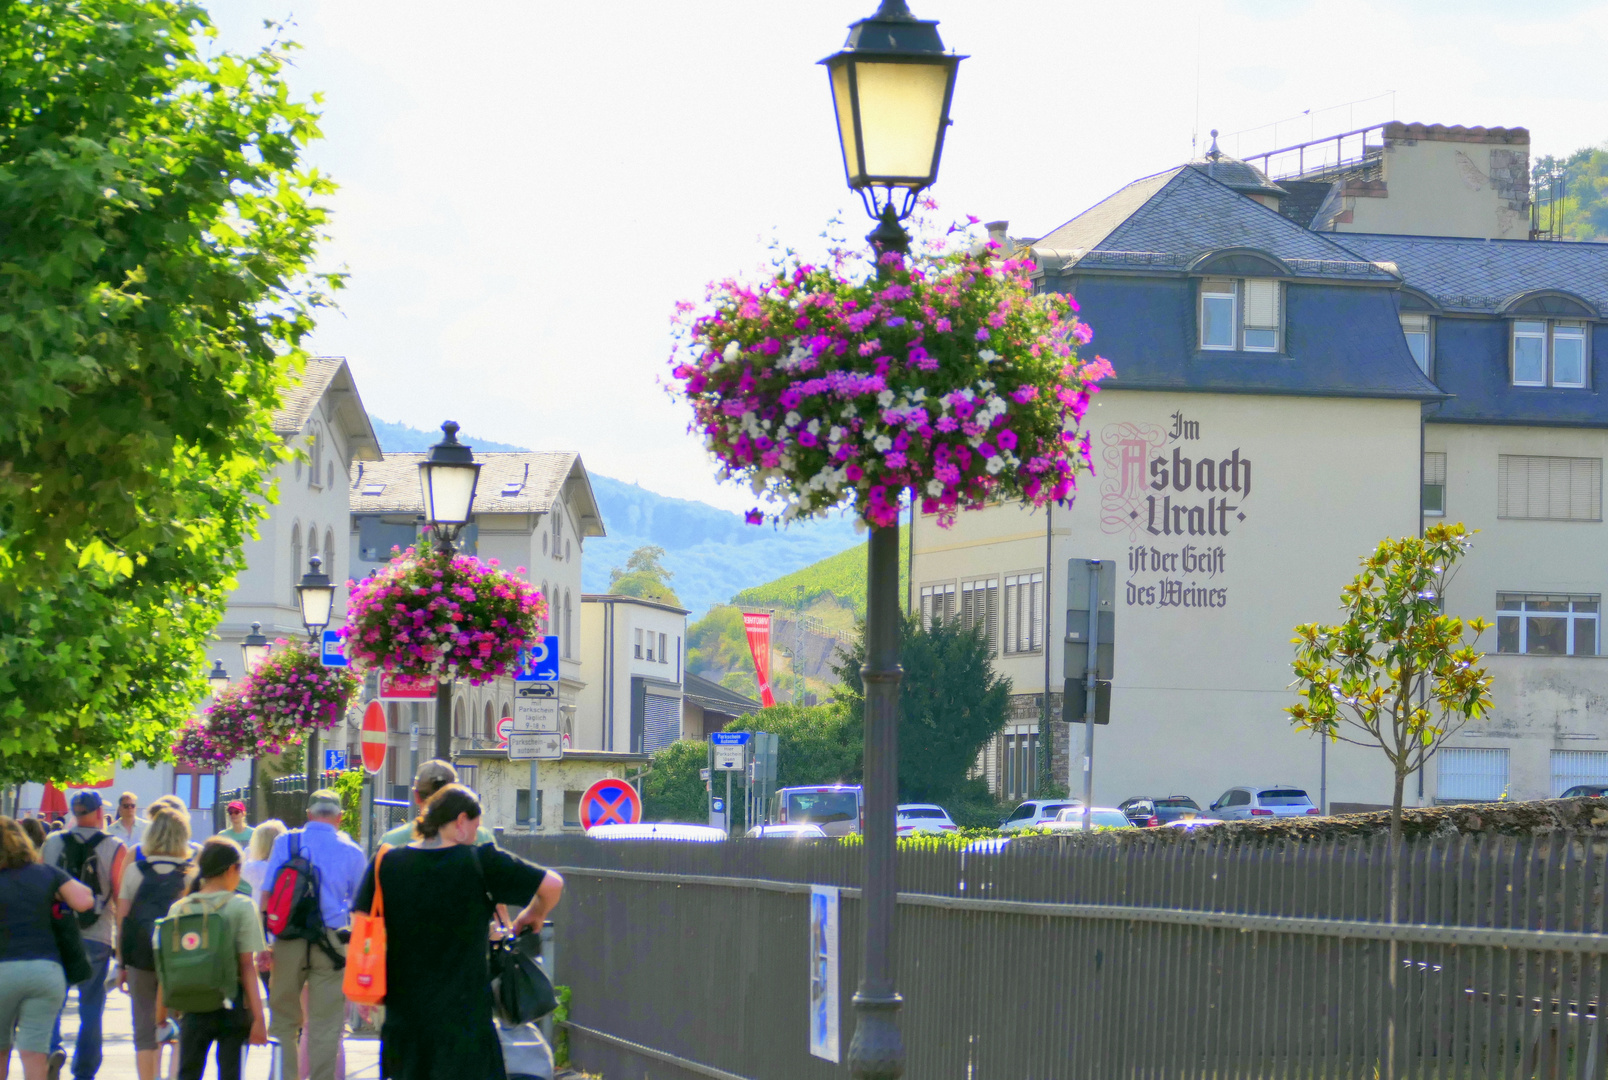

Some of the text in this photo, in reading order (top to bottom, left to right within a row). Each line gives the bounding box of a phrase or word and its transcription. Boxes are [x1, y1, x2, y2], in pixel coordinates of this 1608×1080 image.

[1168, 409, 1201, 443] Im
[1117, 439, 1252, 502] Asbach
[1150, 546, 1178, 573] der
[1126, 577, 1228, 609] des Weines
[524, 642, 549, 676] P
